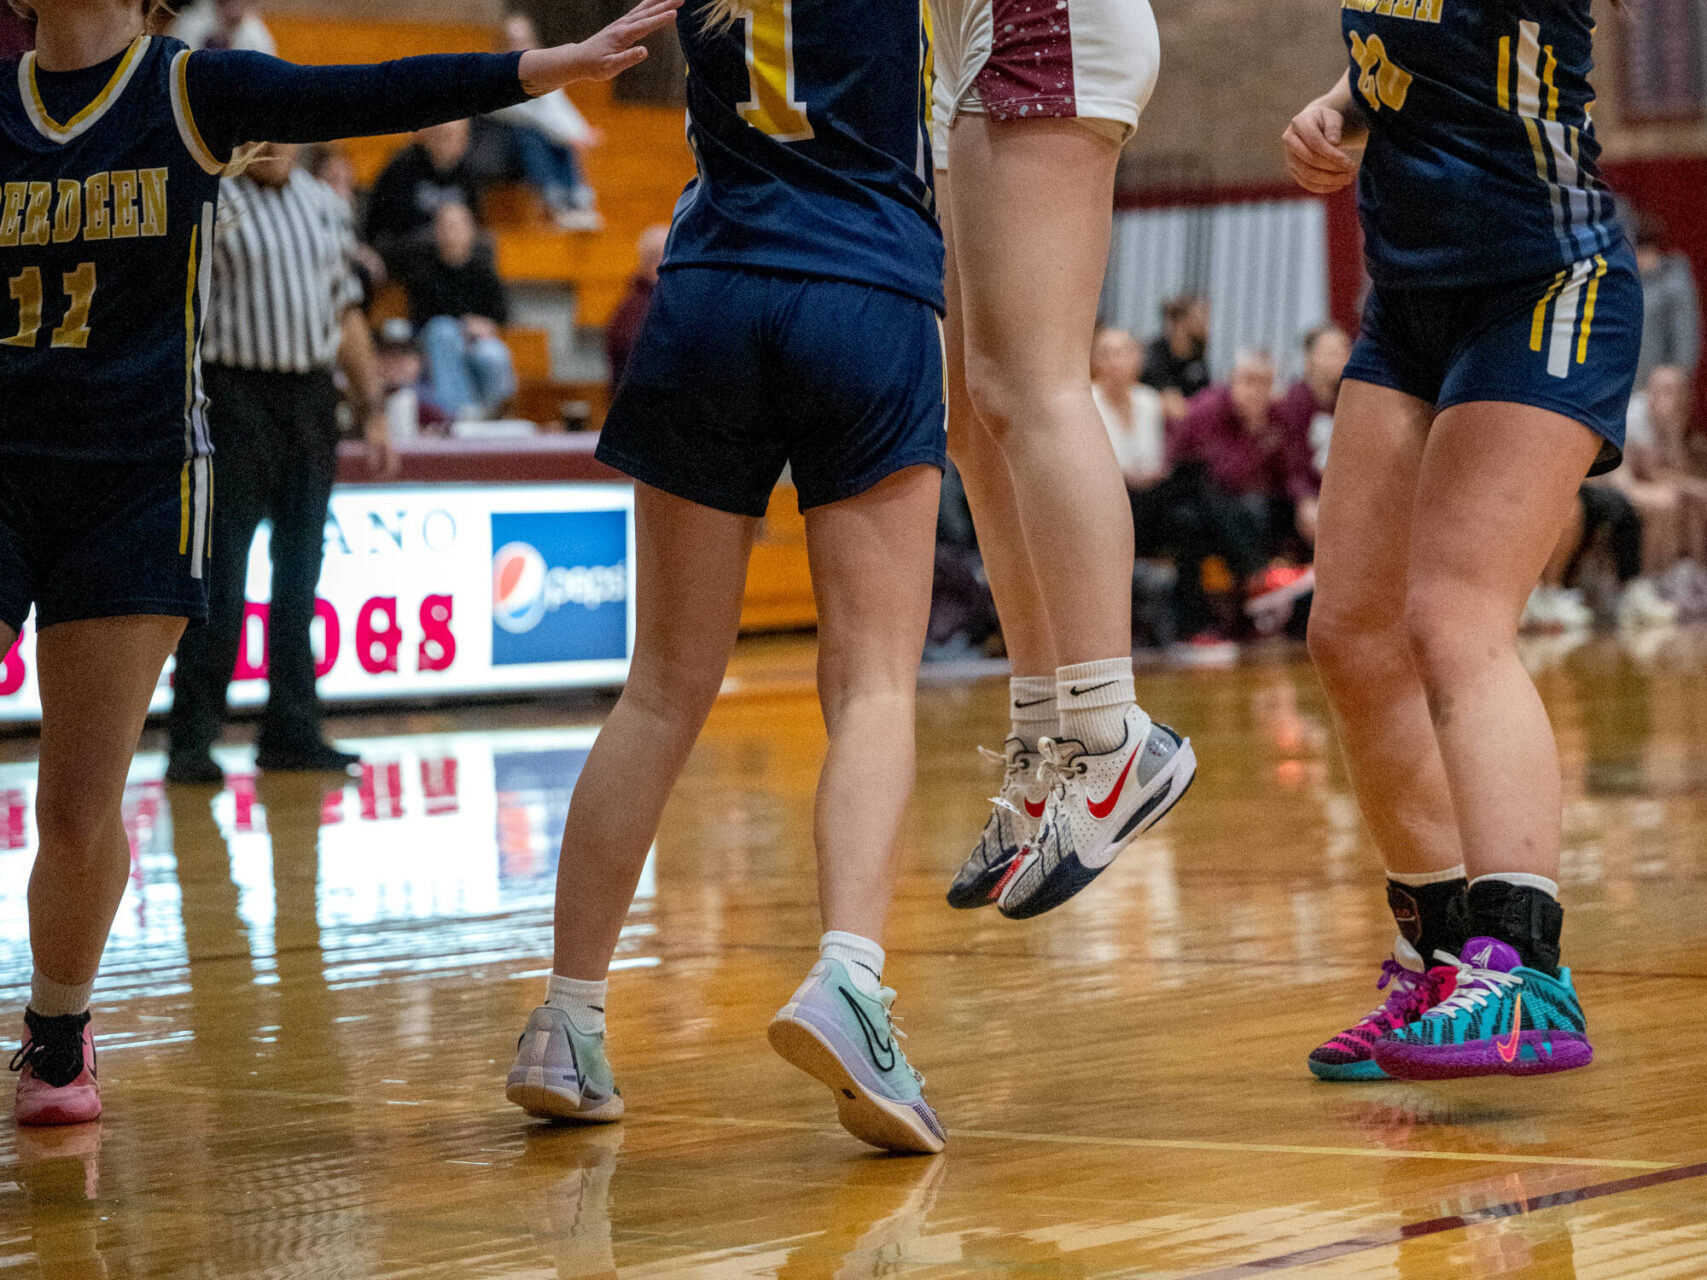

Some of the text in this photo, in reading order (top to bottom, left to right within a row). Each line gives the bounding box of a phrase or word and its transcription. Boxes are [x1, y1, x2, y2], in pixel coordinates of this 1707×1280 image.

[0, 167, 169, 247] ERDEEN
[0, 262, 97, 349] 11
[544, 558, 628, 612] pepsi
